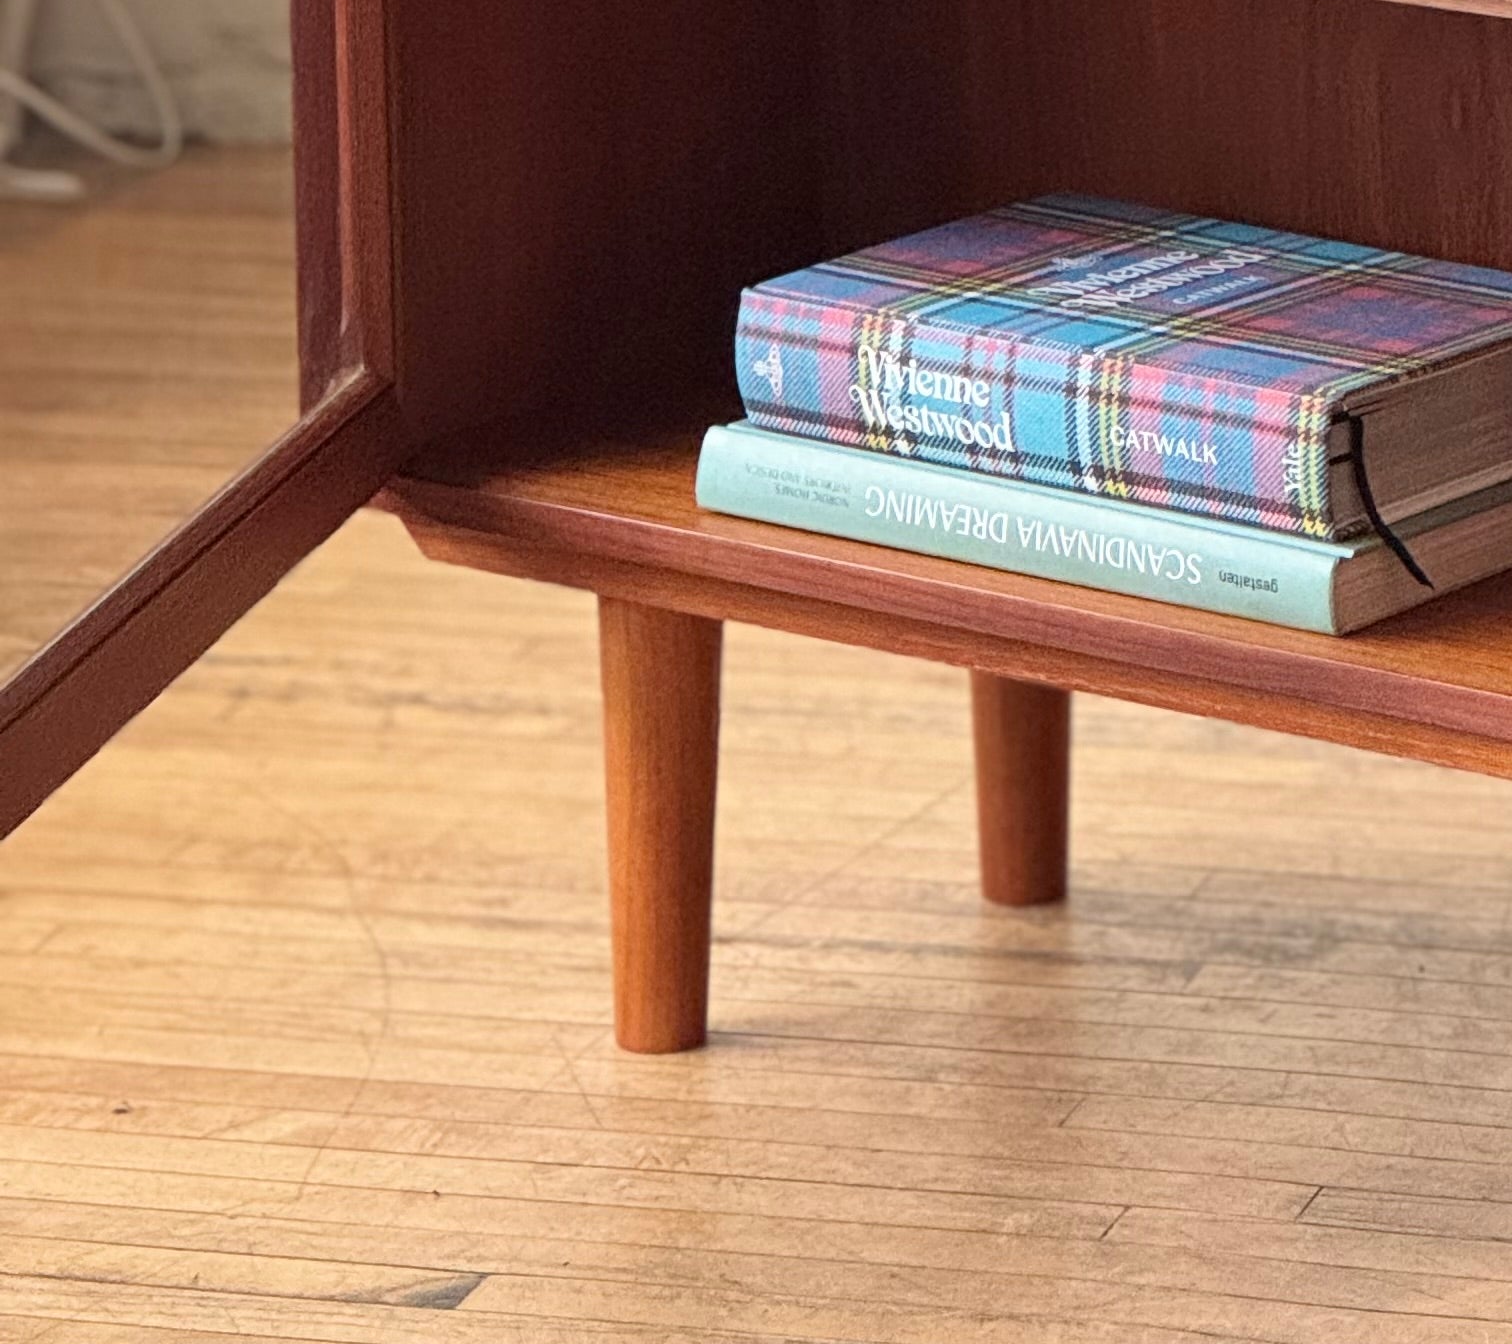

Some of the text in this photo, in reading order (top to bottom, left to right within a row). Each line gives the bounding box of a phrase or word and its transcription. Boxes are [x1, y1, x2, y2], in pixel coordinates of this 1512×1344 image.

[1027, 250, 1200, 297] Vivienne
[1060, 248, 1268, 308] Westwood
[1172, 274, 1266, 305] CATWALK
[858, 344, 990, 408] Vivienne
[849, 384, 1016, 453] Westwood
[1109, 425, 1218, 465] CATWALK
[1281, 442, 1301, 494] Yale
[864, 485, 1203, 585] SCANDINAVIA DREAMING
[1218, 569, 1279, 595] gestalten
